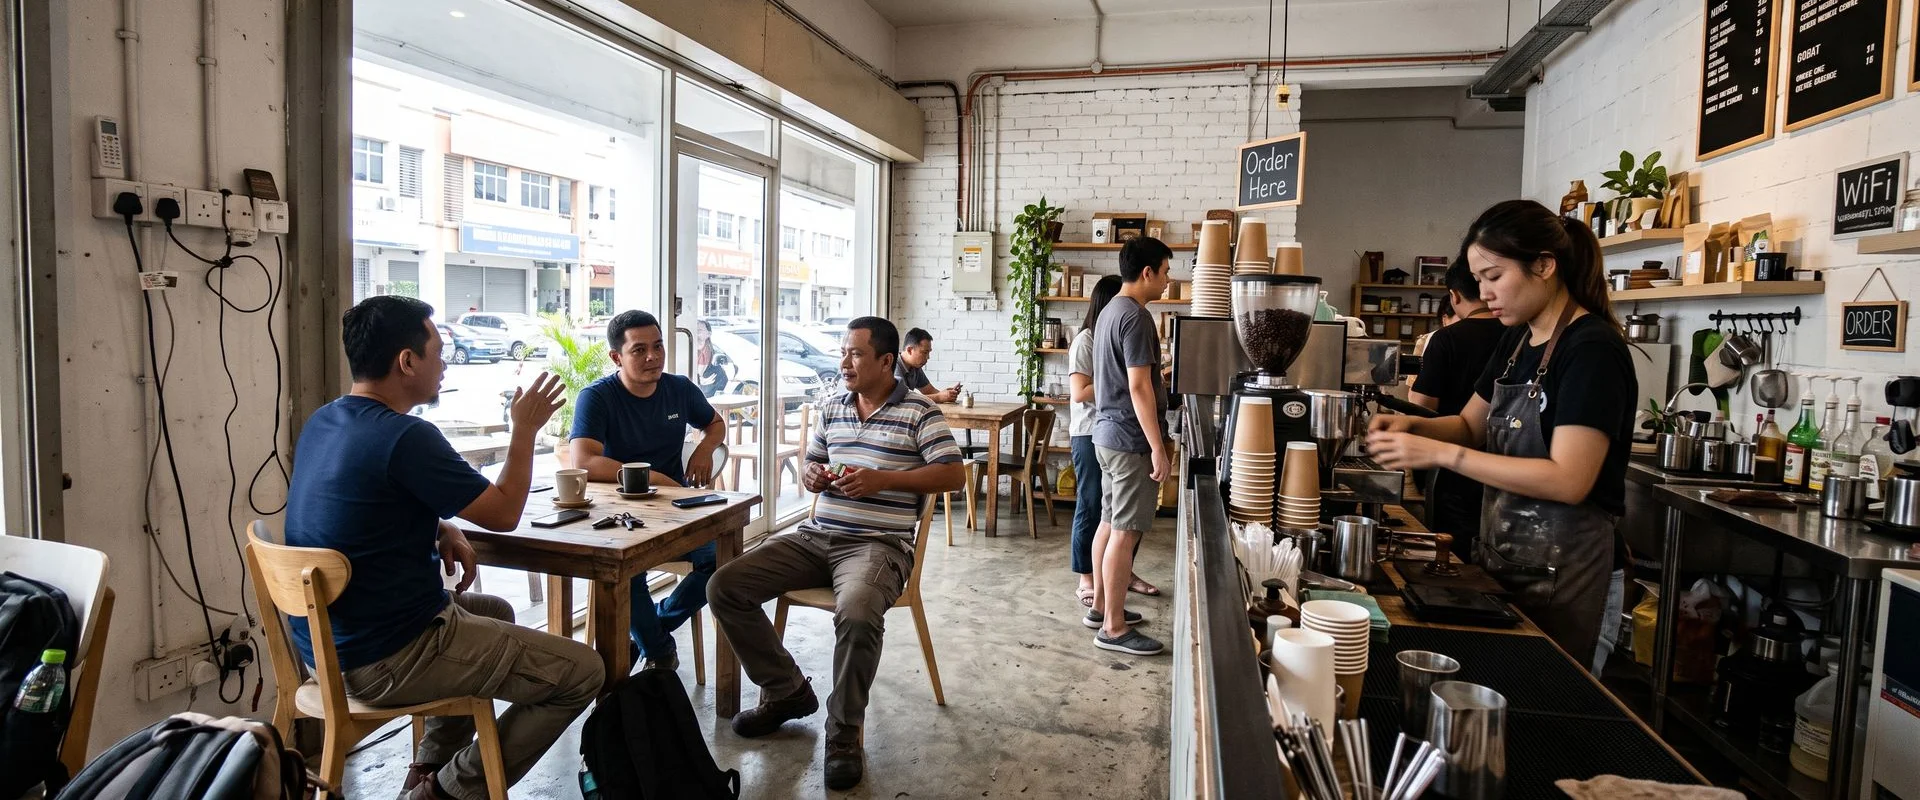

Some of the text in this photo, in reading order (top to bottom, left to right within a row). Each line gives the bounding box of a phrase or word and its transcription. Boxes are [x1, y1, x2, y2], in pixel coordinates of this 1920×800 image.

[1246, 147, 1293, 175] Order
[1249, 176, 1287, 200] Here
[1842, 167, 1892, 207] WiFi
[1845, 309, 1892, 336] ORDER
